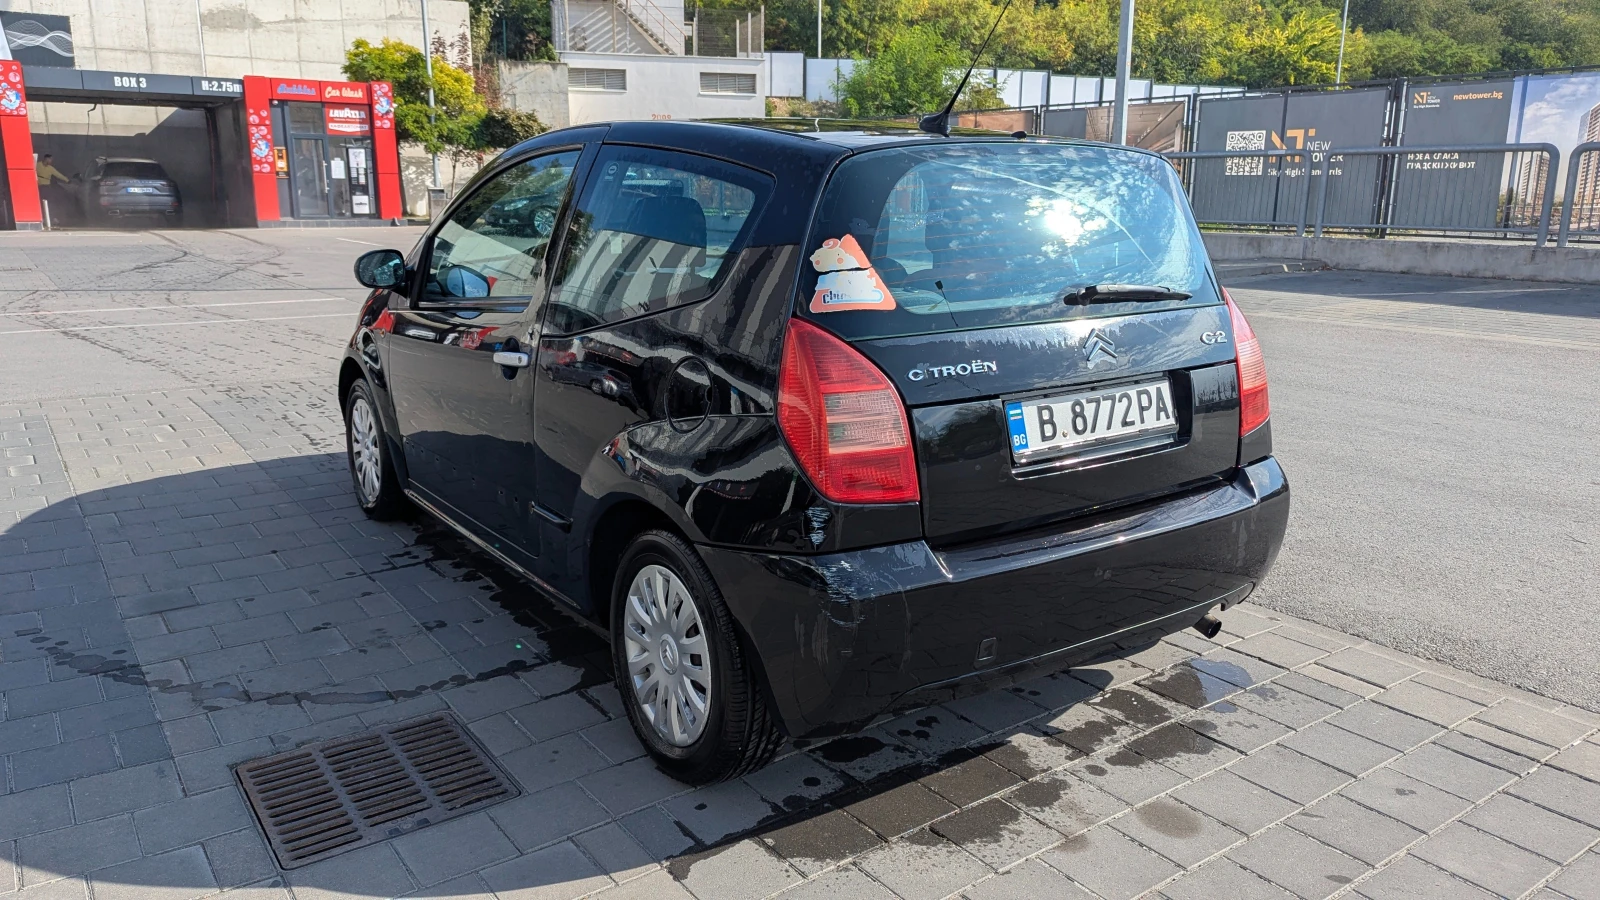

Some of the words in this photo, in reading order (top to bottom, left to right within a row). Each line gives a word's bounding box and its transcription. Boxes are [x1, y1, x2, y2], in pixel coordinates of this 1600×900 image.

[113, 76, 138, 88] BOX
[139, 77, 147, 88] 3
[201, 80, 243, 93] H:2.75m
[325, 86, 341, 99] Car
[341, 87, 363, 98] Wash
[1453, 90, 1503, 101] newtower.bg
[329, 108, 366, 119] LAVAZZA
[1306, 141, 1331, 151] NEW
[1200, 330, 1227, 345] C2
[908, 360, 997, 381] CTROËN
[1037, 405, 1057, 442] B
[1013, 434, 1027, 446] BG
